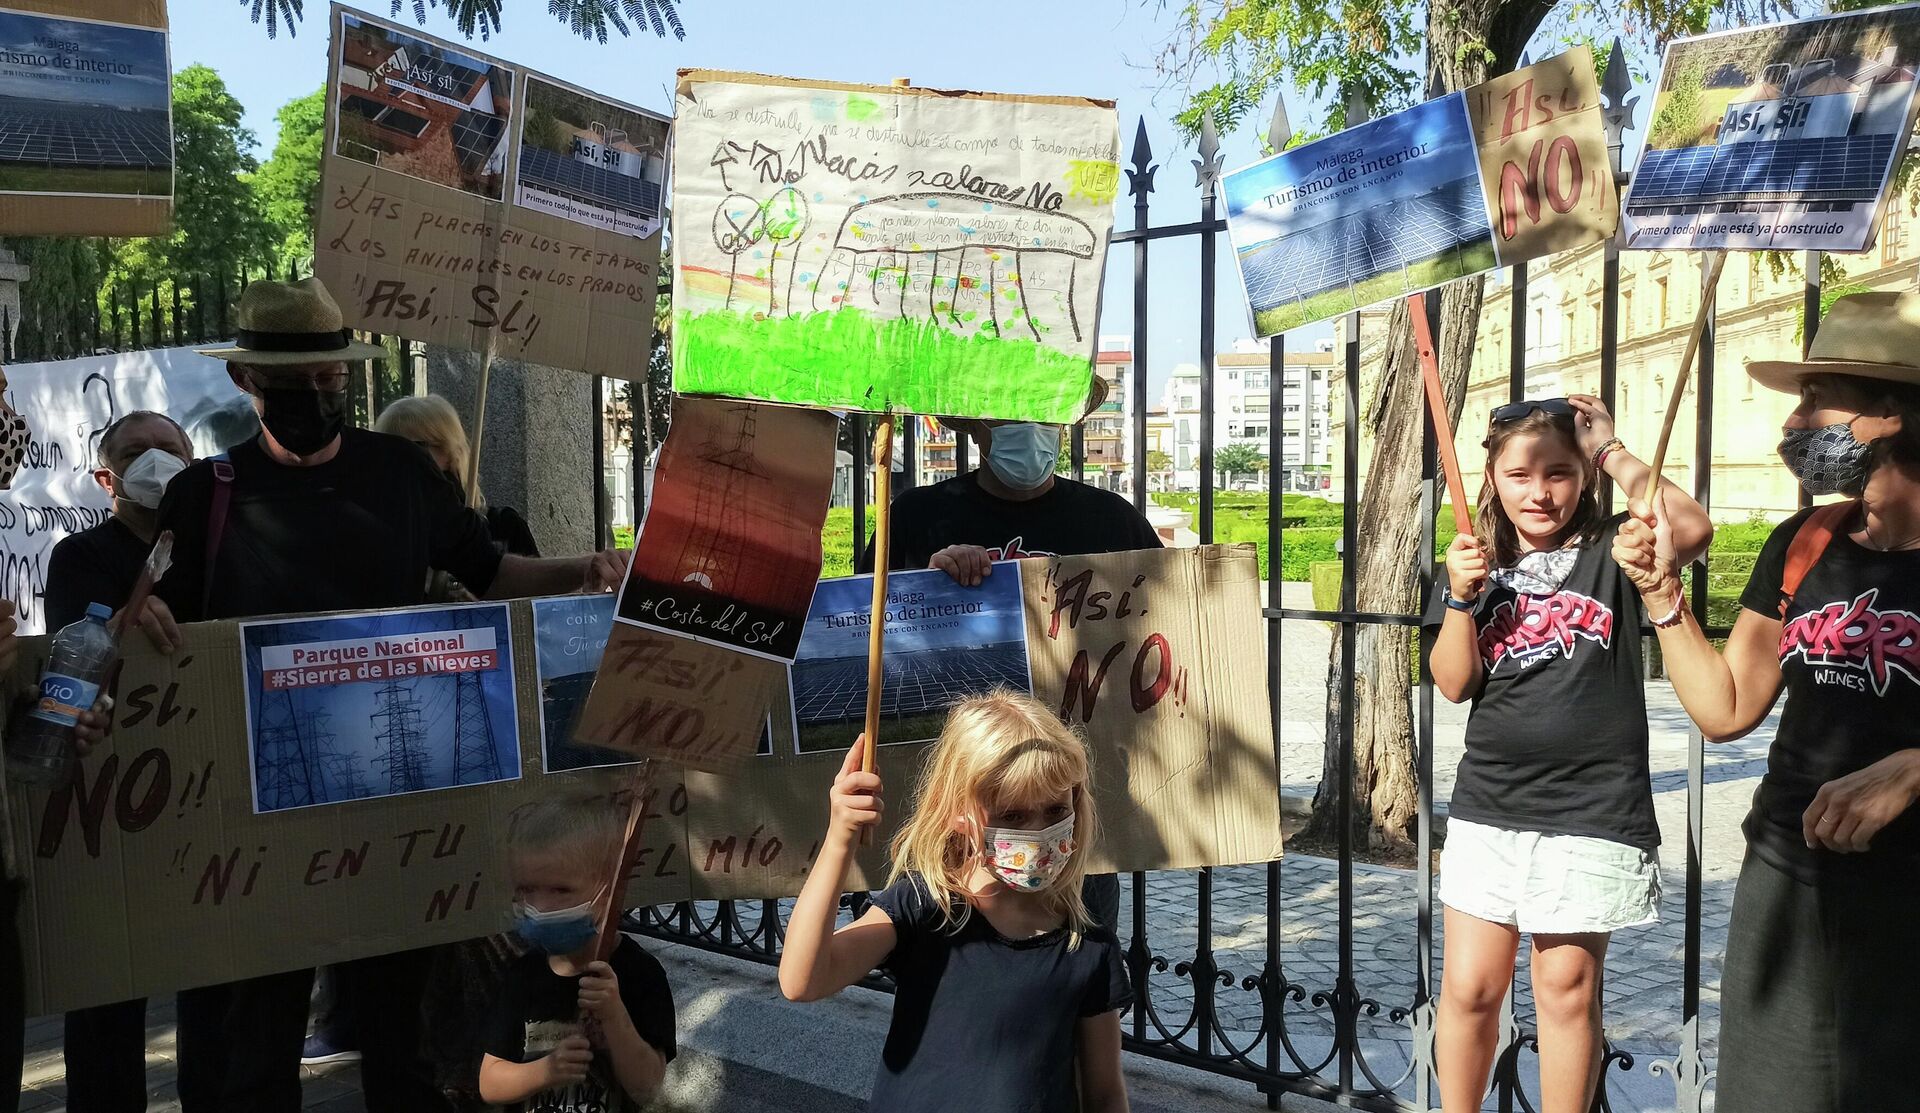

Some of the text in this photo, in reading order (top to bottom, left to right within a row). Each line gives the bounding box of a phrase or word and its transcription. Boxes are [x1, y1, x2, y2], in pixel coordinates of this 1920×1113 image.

[52, 53, 71, 69] de
[75, 56, 134, 76] interior
[406, 64, 453, 91] ¡Así sí!
[1774, 100, 1811, 129] Sí!
[1316, 147, 1364, 172] Málaga
[1263, 141, 1428, 209] Turismo de interior
[1342, 185, 1361, 195] CON
[1362, 169, 1404, 188] ENCANTO
[526, 192, 553, 207] Primero
[554, 201, 570, 212] todo
[577, 208, 591, 220] que
[590, 210, 605, 222] está
[605, 215, 614, 225] ya
[613, 218, 648, 233] construido
[414, 212, 494, 241] PLACAS
[500, 229, 524, 246] EN
[530, 235, 562, 255] LOS
[1637, 221, 1845, 237] rimero todo lo que está ya construido
[405, 248, 512, 277] ANIMALES
[518, 265, 543, 282] EN
[547, 268, 576, 287] LOS
[640, 597, 785, 645] #Costa del Sol
[823, 600, 984, 630] Turiso de interior
[901, 625, 918, 634] CON
[920, 620, 960, 632] ENCANTO
[292, 633, 465, 666] Parque Nacional
[271, 653, 492, 688] #Sierra de las Nieves
[1815, 669, 1866, 692] WINES
[44, 681, 74, 701] ViO
[303, 840, 371, 886] EN
[393, 823, 466, 868] TU
